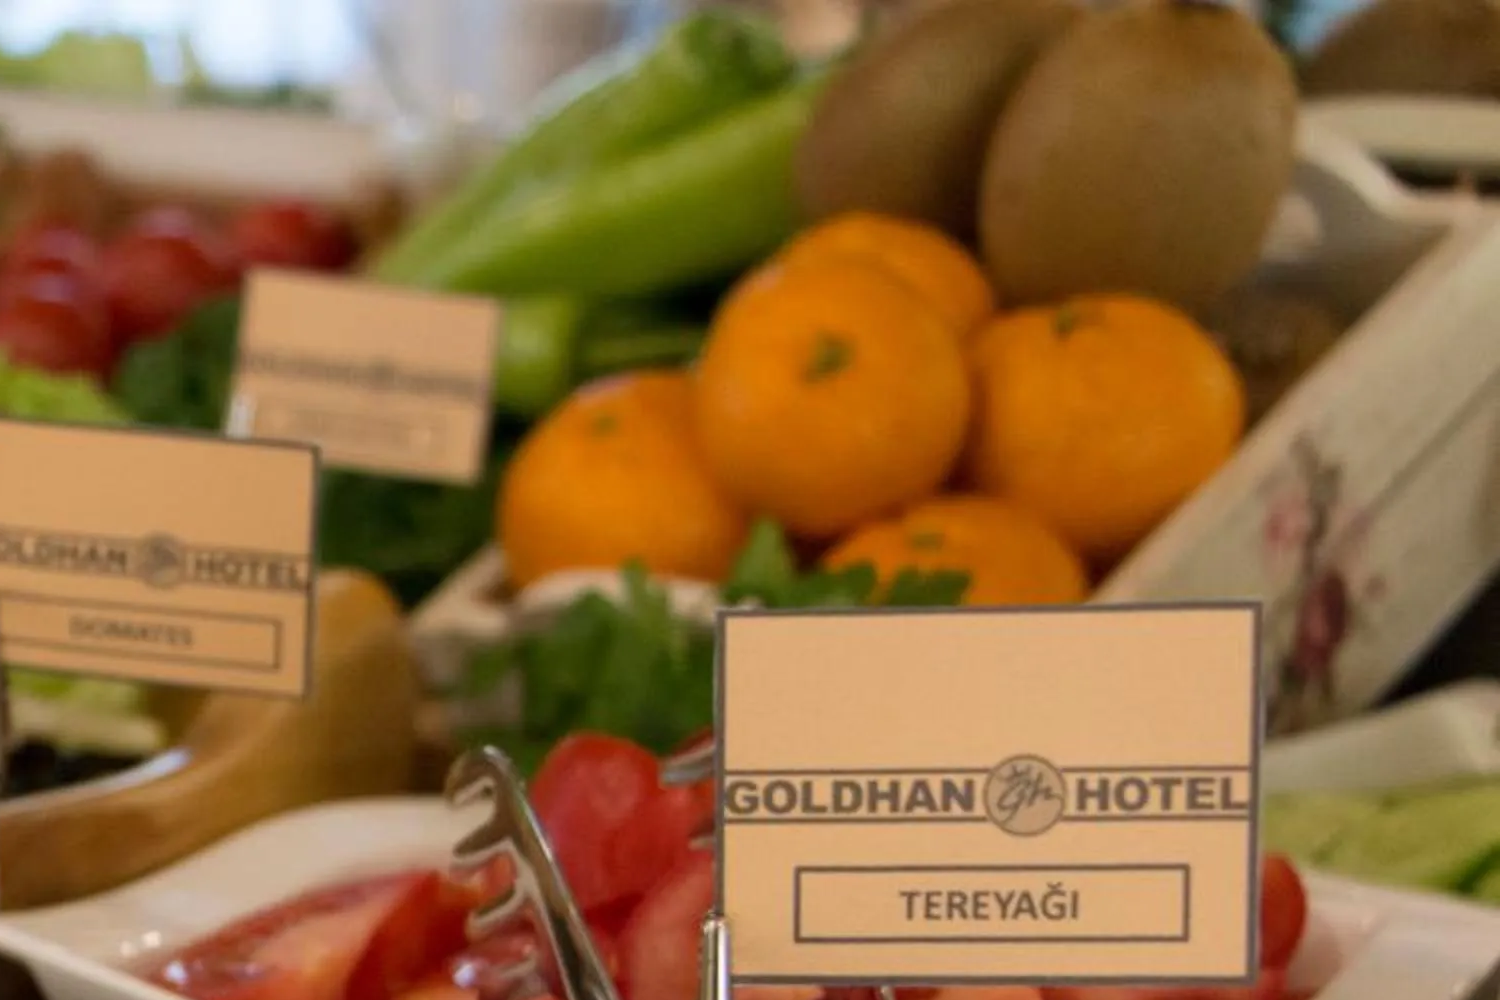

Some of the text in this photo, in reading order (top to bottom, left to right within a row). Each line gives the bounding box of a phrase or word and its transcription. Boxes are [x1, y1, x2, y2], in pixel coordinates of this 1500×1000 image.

[193, 551, 309, 590] HOTEL
[724, 778, 976, 816] GOLDHAN
[1076, 774, 1249, 812] HOTEL
[899, 882, 1080, 921] TEREYAĞI
